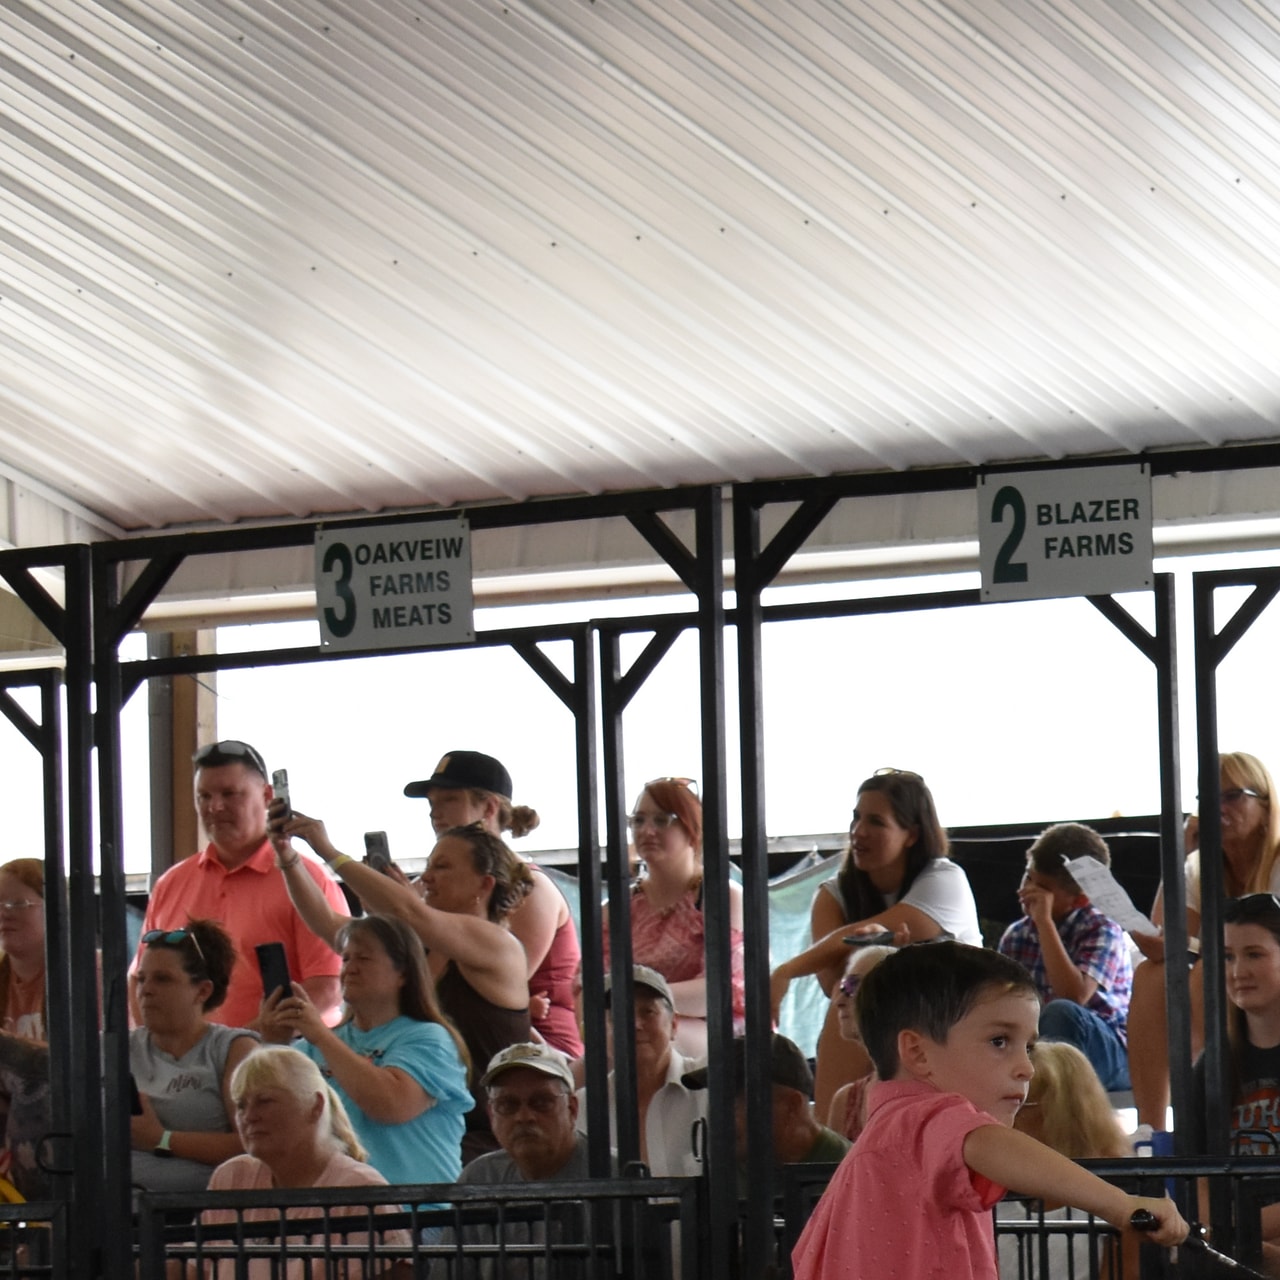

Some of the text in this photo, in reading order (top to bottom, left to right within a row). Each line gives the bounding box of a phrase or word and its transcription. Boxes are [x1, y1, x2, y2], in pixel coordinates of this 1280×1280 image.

[1036, 498, 1140, 526] BLAZER
[991, 485, 1028, 584] 2
[1044, 532, 1134, 560] FARMS
[355, 537, 463, 565] OAKVEIW
[322, 542, 357, 638] 3
[369, 570, 451, 596] FARMS
[372, 603, 452, 629] MEATS
